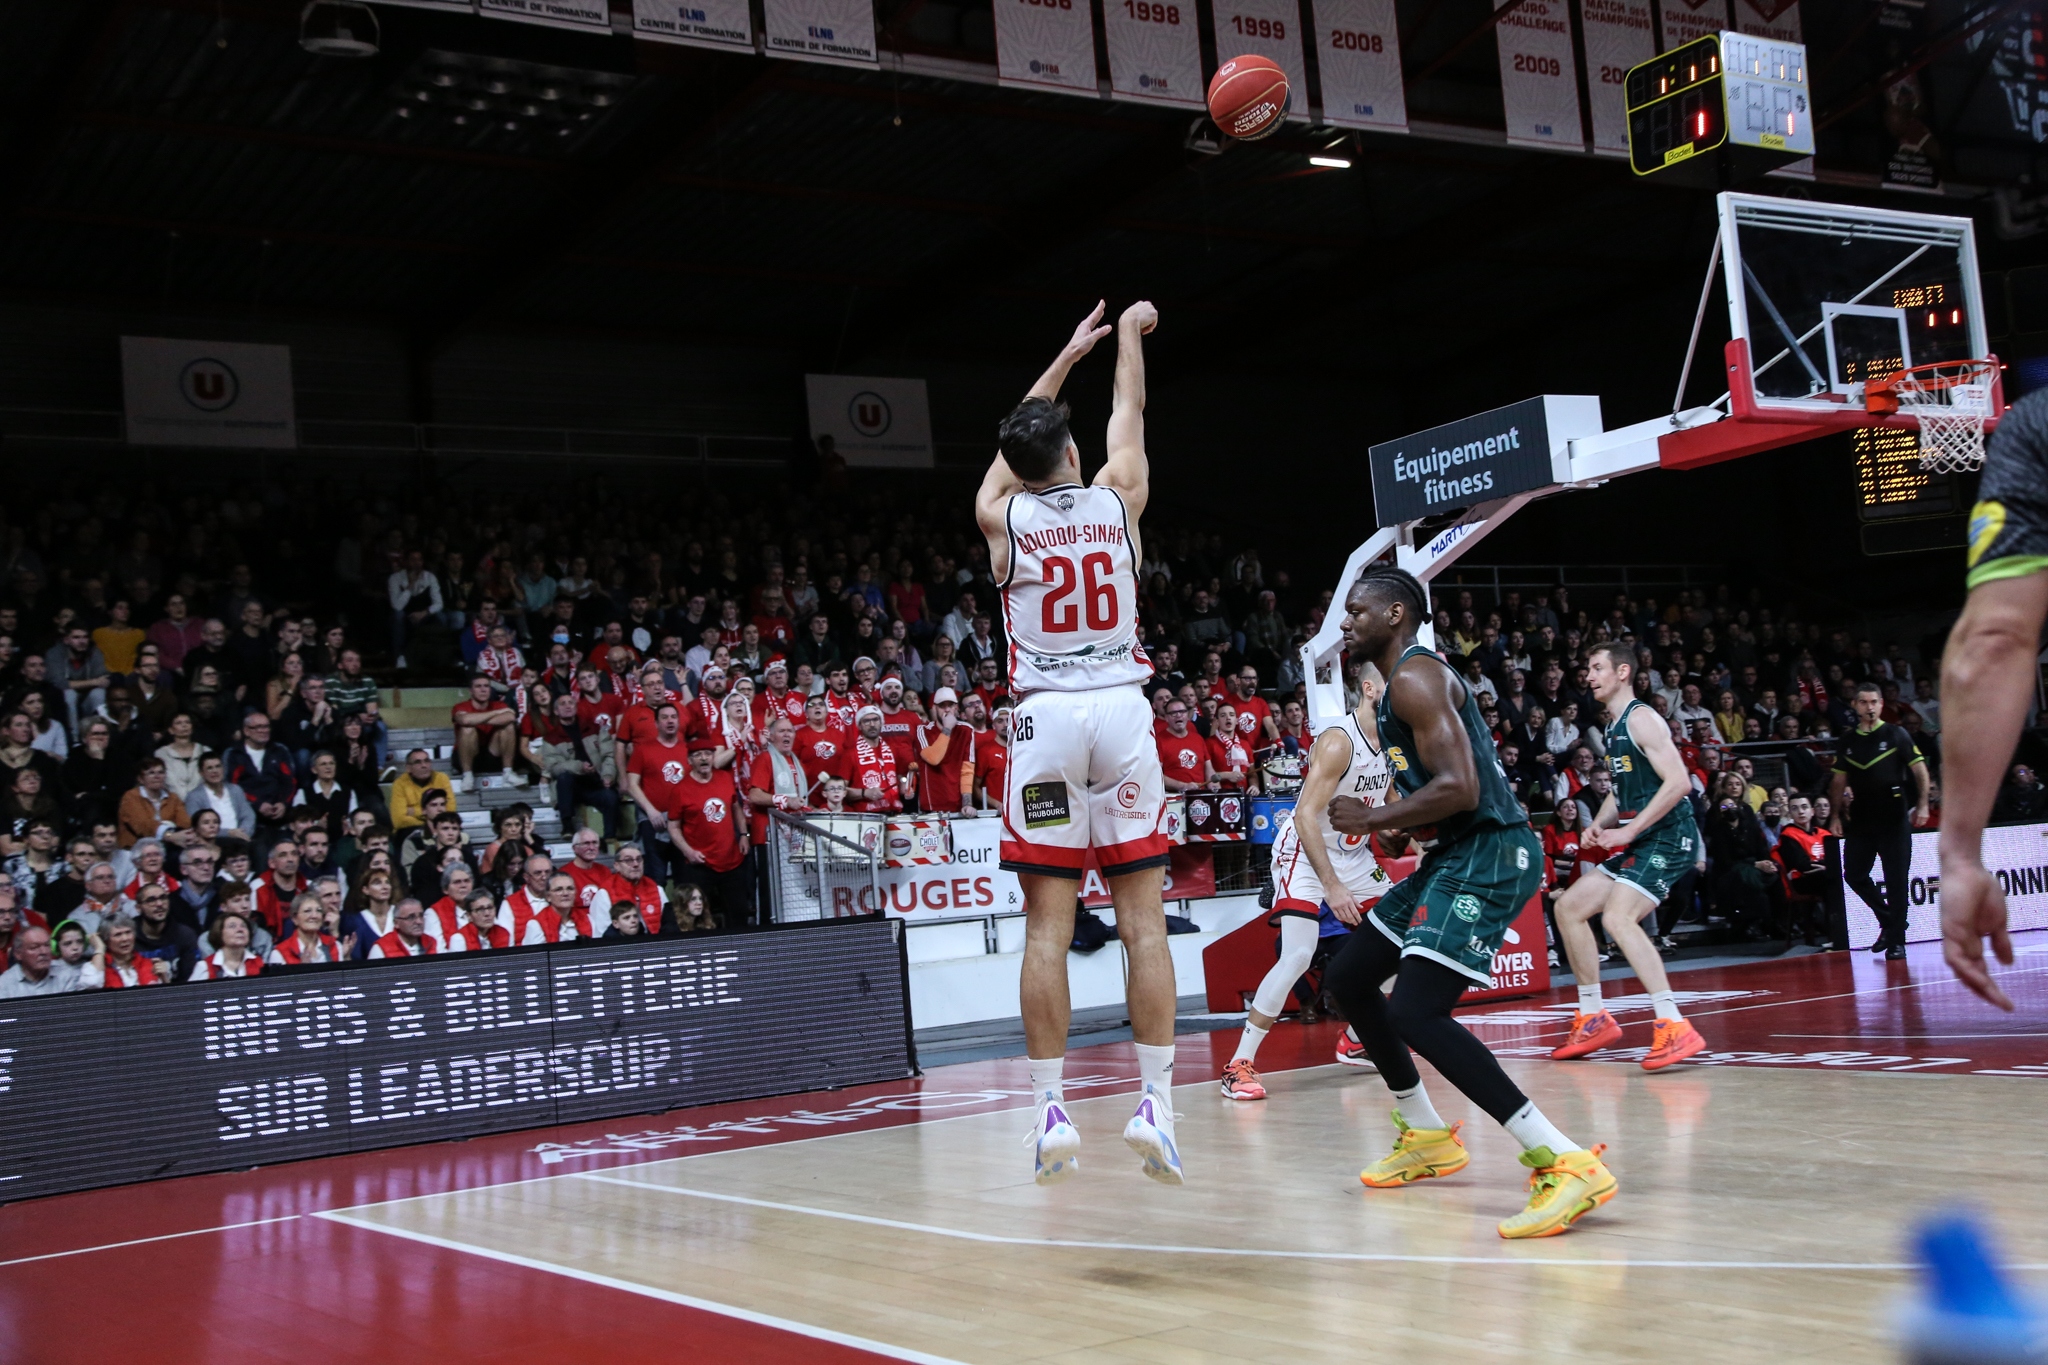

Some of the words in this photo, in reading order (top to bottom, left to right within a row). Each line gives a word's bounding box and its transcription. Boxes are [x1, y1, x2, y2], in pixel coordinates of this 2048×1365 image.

[545, 4, 601, 20] FORMATION
[1123, 0, 1180, 25] 1998
[1500, 14, 1567, 33] CHALLENGE
[1583, 10, 1651, 30] CHAMPIONS
[640, 18, 675, 31] CENTRE
[680, 22, 692, 33] DE
[694, 23, 746, 41] FORMATION
[1231, 15, 1286, 40] 1999
[772, 36, 806, 50] CENTRE
[808, 41, 820, 51] DE
[823, 43, 872, 58] FORMATION
[1331, 29, 1384, 53] 2008
[1513, 53, 1561, 77] 2009
[1601, 66, 1623, 84] 20
[1234, 102, 1277, 134] LEGACY
[1667, 146, 1692, 161] Bodet
[1393, 426, 1520, 483] Équipement
[1424, 469, 1495, 505] fitness
[1042, 551, 1119, 633] 26
[881, 724, 911, 732] ADIDAS
[1016, 716, 1034, 742] 26
[1354, 773, 1388, 793] CHOLET
[1027, 801, 1055, 811] L'AUTRE
[1028, 808, 1066, 820] FAUBOURG
[1189, 805, 1210, 815] CHOLET
[920, 836, 939, 847] CHOLET
[1516, 845, 1530, 870] 6
[832, 877, 993, 919] ROUGES
[1008, 891, 1018, 904] &
[1456, 898, 1479, 916] CSP
[1490, 951, 1534, 974] UYER
[203, 986, 367, 1060] INFOS
[386, 980, 427, 1040] &
[445, 950, 742, 1034] BILLETTERIE
[218, 1072, 331, 1140] SUR
